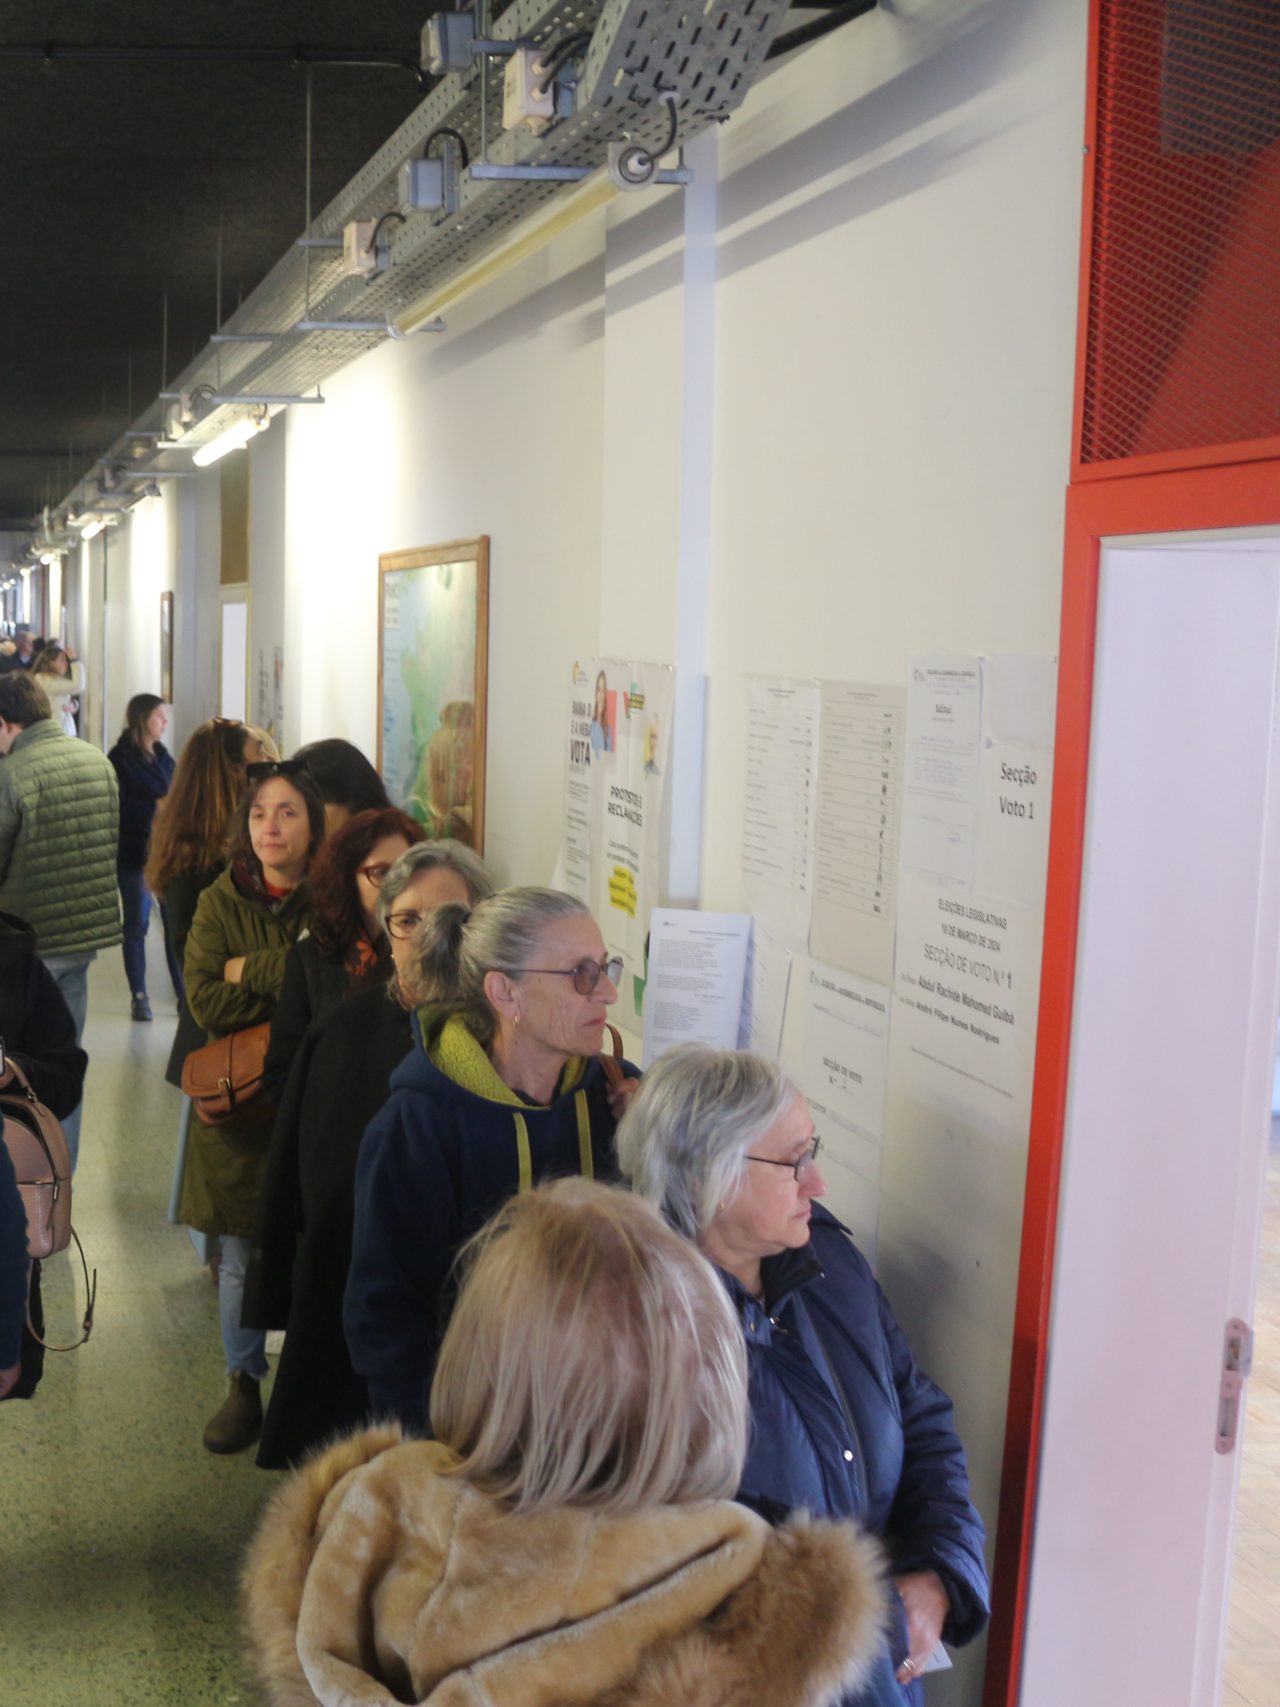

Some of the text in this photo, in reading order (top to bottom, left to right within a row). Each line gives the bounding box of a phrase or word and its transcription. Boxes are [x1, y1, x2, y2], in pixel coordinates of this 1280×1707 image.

[570, 738, 590, 766] VOTA
[1000, 762, 1037, 786] Secção
[999, 796, 1034, 820] Voto 1
[966, 907, 1007, 930] LEGISLATIVAS
[957, 928, 977, 944] MARÇO
[924, 943, 955, 968] SECÇÃO
[956, 955, 967, 974] DE
[968, 960, 992, 982] VOTO
[1007, 972, 1012, 990] 1
